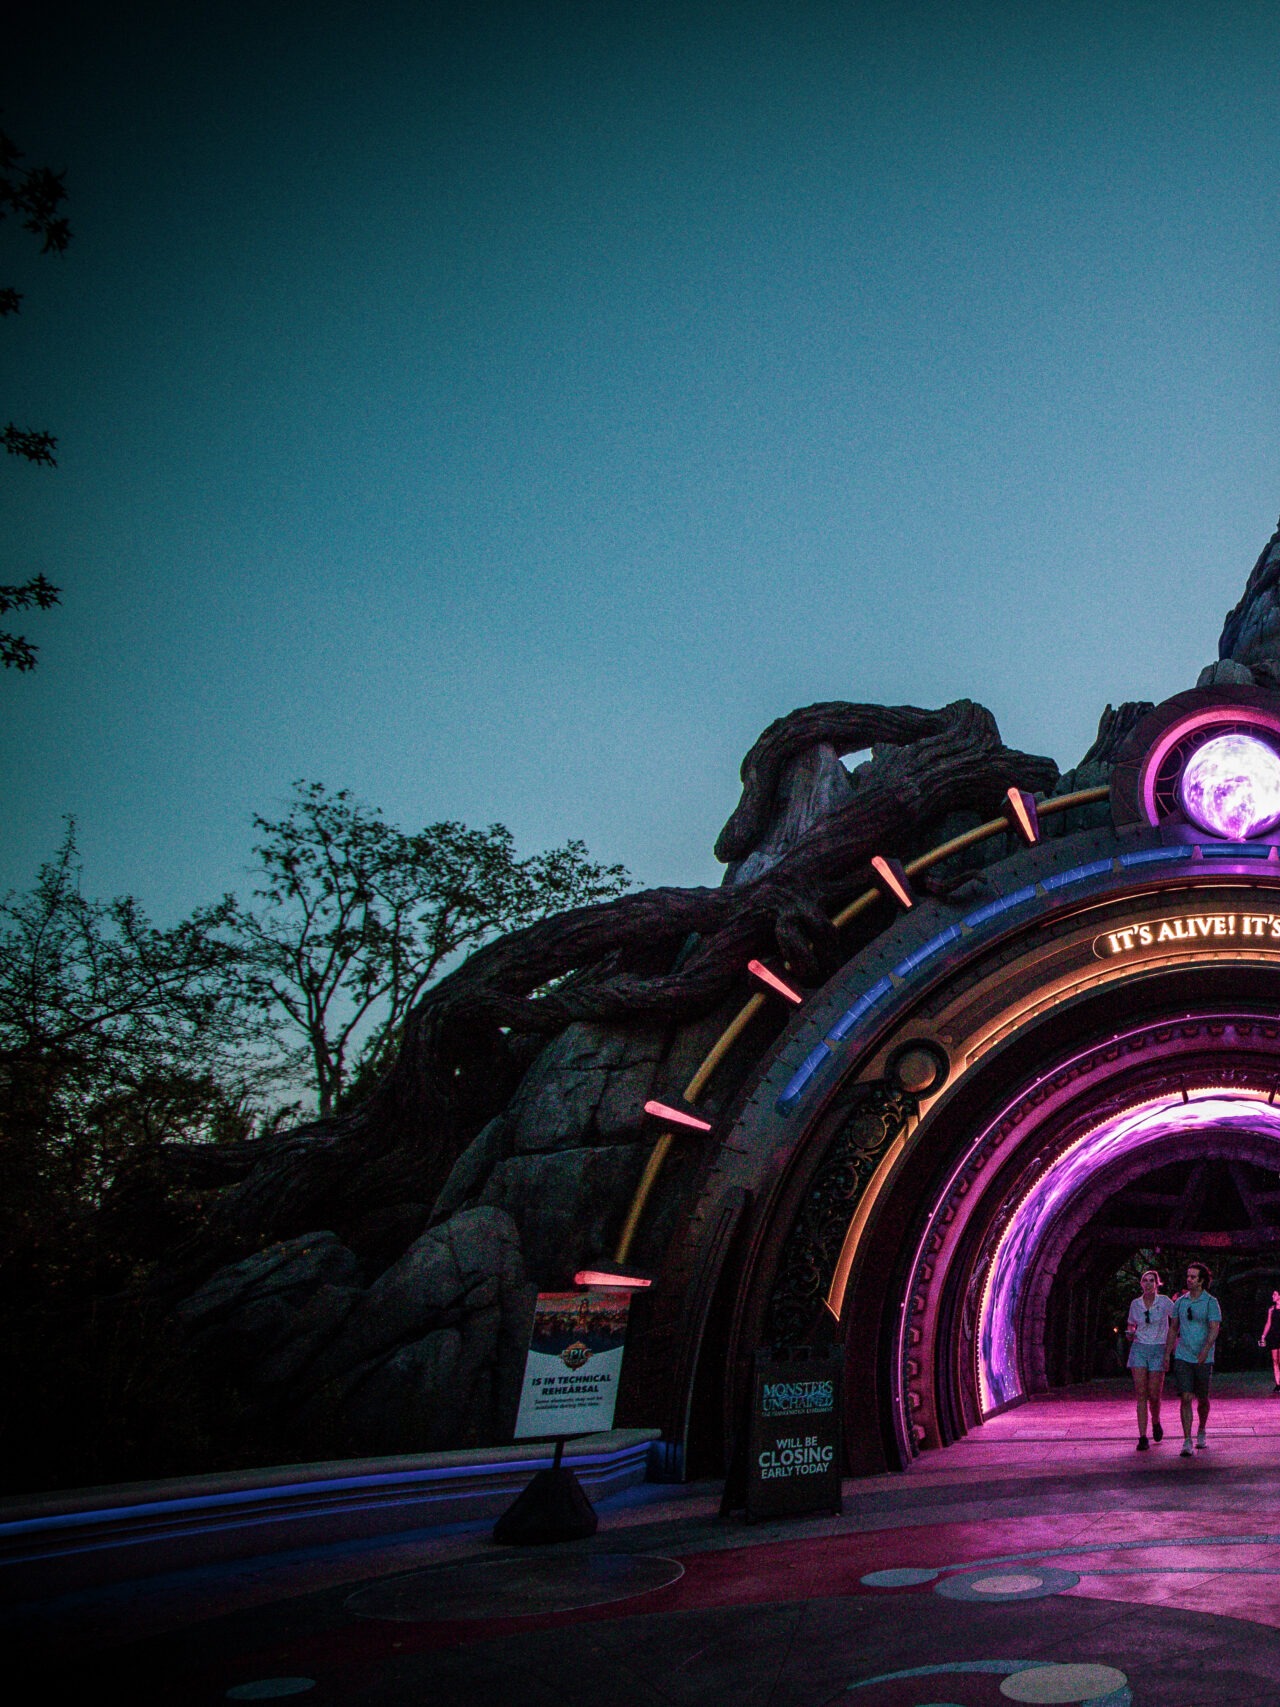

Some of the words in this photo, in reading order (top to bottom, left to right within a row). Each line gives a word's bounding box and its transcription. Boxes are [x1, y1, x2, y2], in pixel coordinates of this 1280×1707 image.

[1108, 925, 1150, 953] IT'S
[1157, 915, 1235, 942] ALIVE!
[532, 1377, 542, 1386] IS
[544, 1377, 555, 1385] IN
[558, 1374, 612, 1384] TECHNICAL
[542, 1385, 599, 1395] REHEARSAL
[763, 1380, 833, 1397] MONSTERS
[763, 1396, 833, 1410] UNCHAINED
[776, 1437, 803, 1449] WILL
[804, 1435, 818, 1447] BE
[758, 1446, 833, 1467] CLOSING
[761, 1465, 793, 1479] EARLY
[796, 1463, 829, 1476] TODAY
